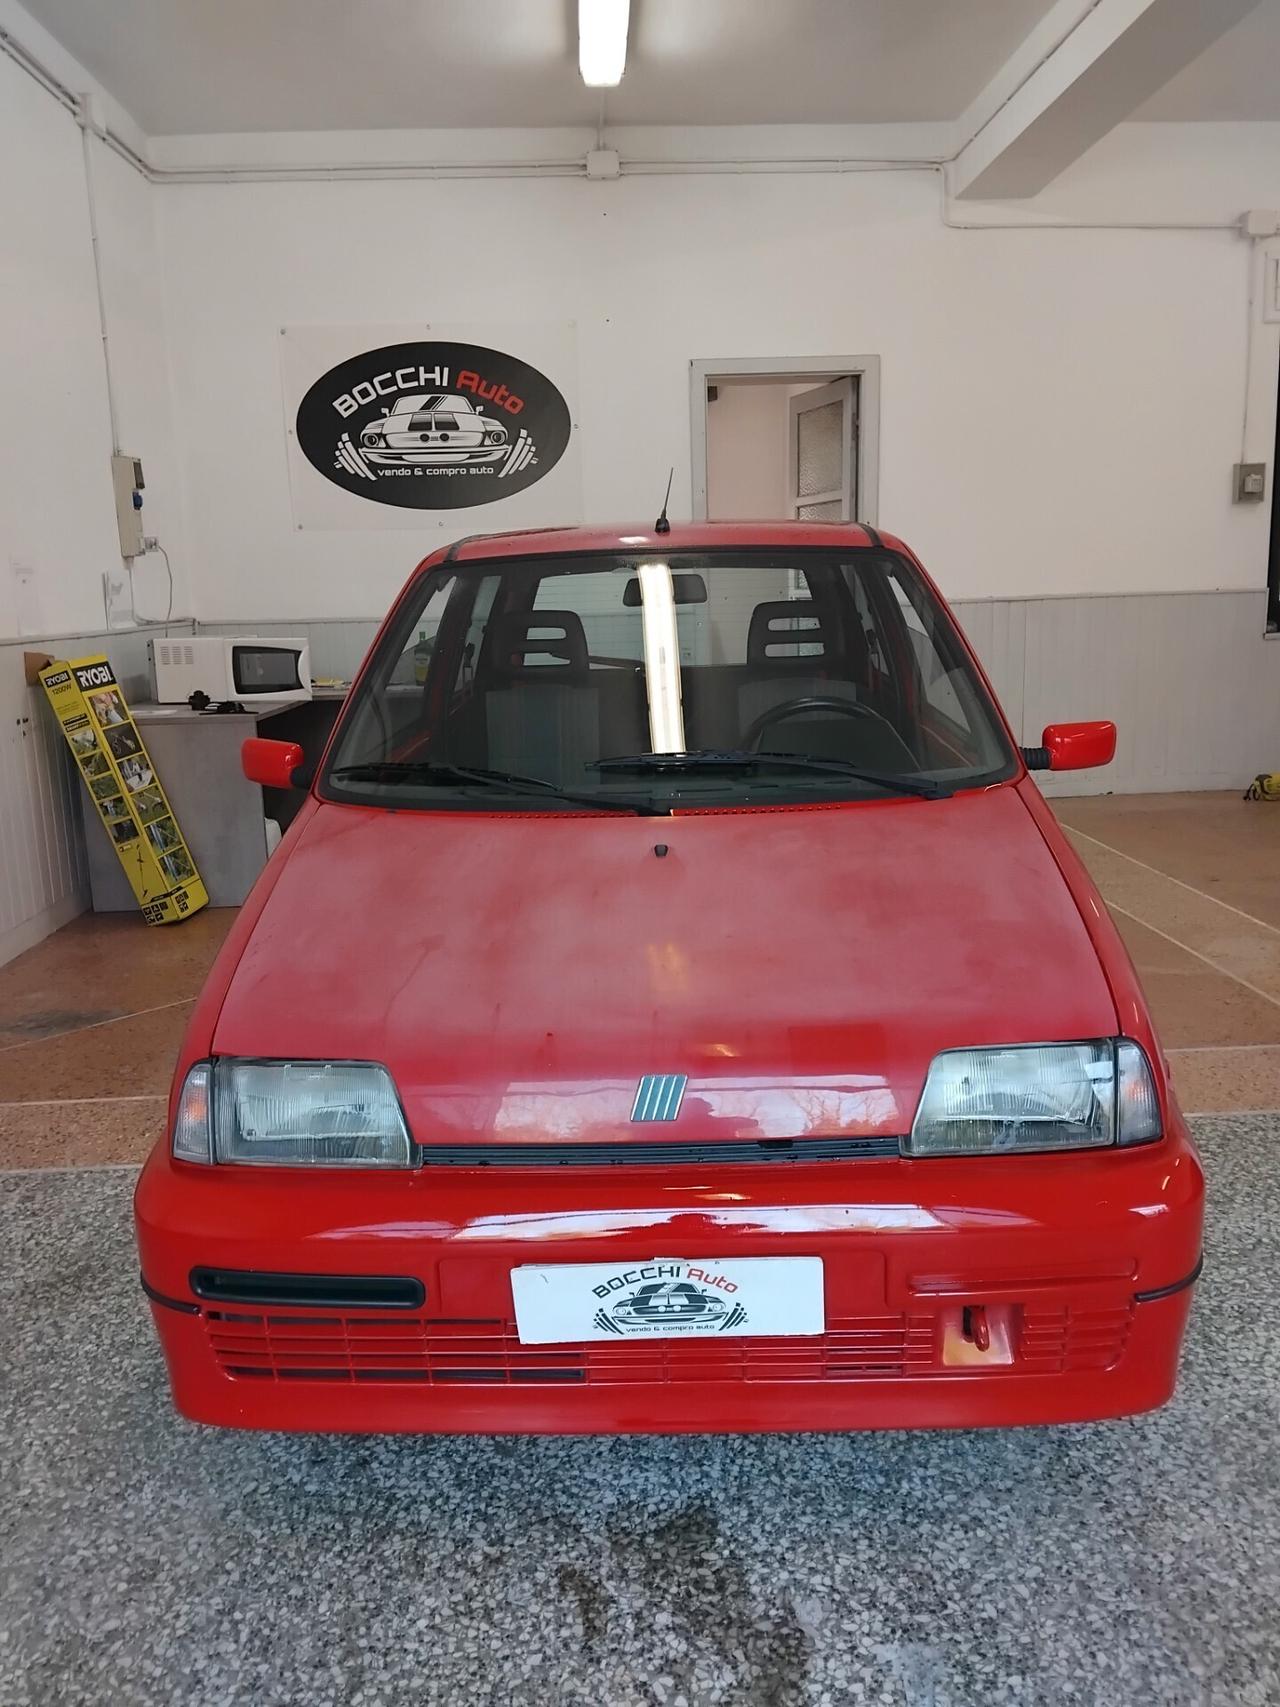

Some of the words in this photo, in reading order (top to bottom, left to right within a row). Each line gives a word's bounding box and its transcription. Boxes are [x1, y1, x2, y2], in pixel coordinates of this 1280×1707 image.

[332, 366, 449, 419] BOCCHI
[456, 369, 524, 414] Auto
[378, 467, 411, 476] vendo
[414, 467, 423, 476] &
[426, 467, 467, 477] compro
[469, 466, 494, 475] auto
[45, 673, 69, 686] RYOBI
[76, 665, 112, 687] RYOBI
[52, 684, 72, 695] 1200W
[592, 1266, 681, 1299] BOCCHI
[687, 1268, 738, 1293] Auto
[662, 1324, 694, 1332] compro
